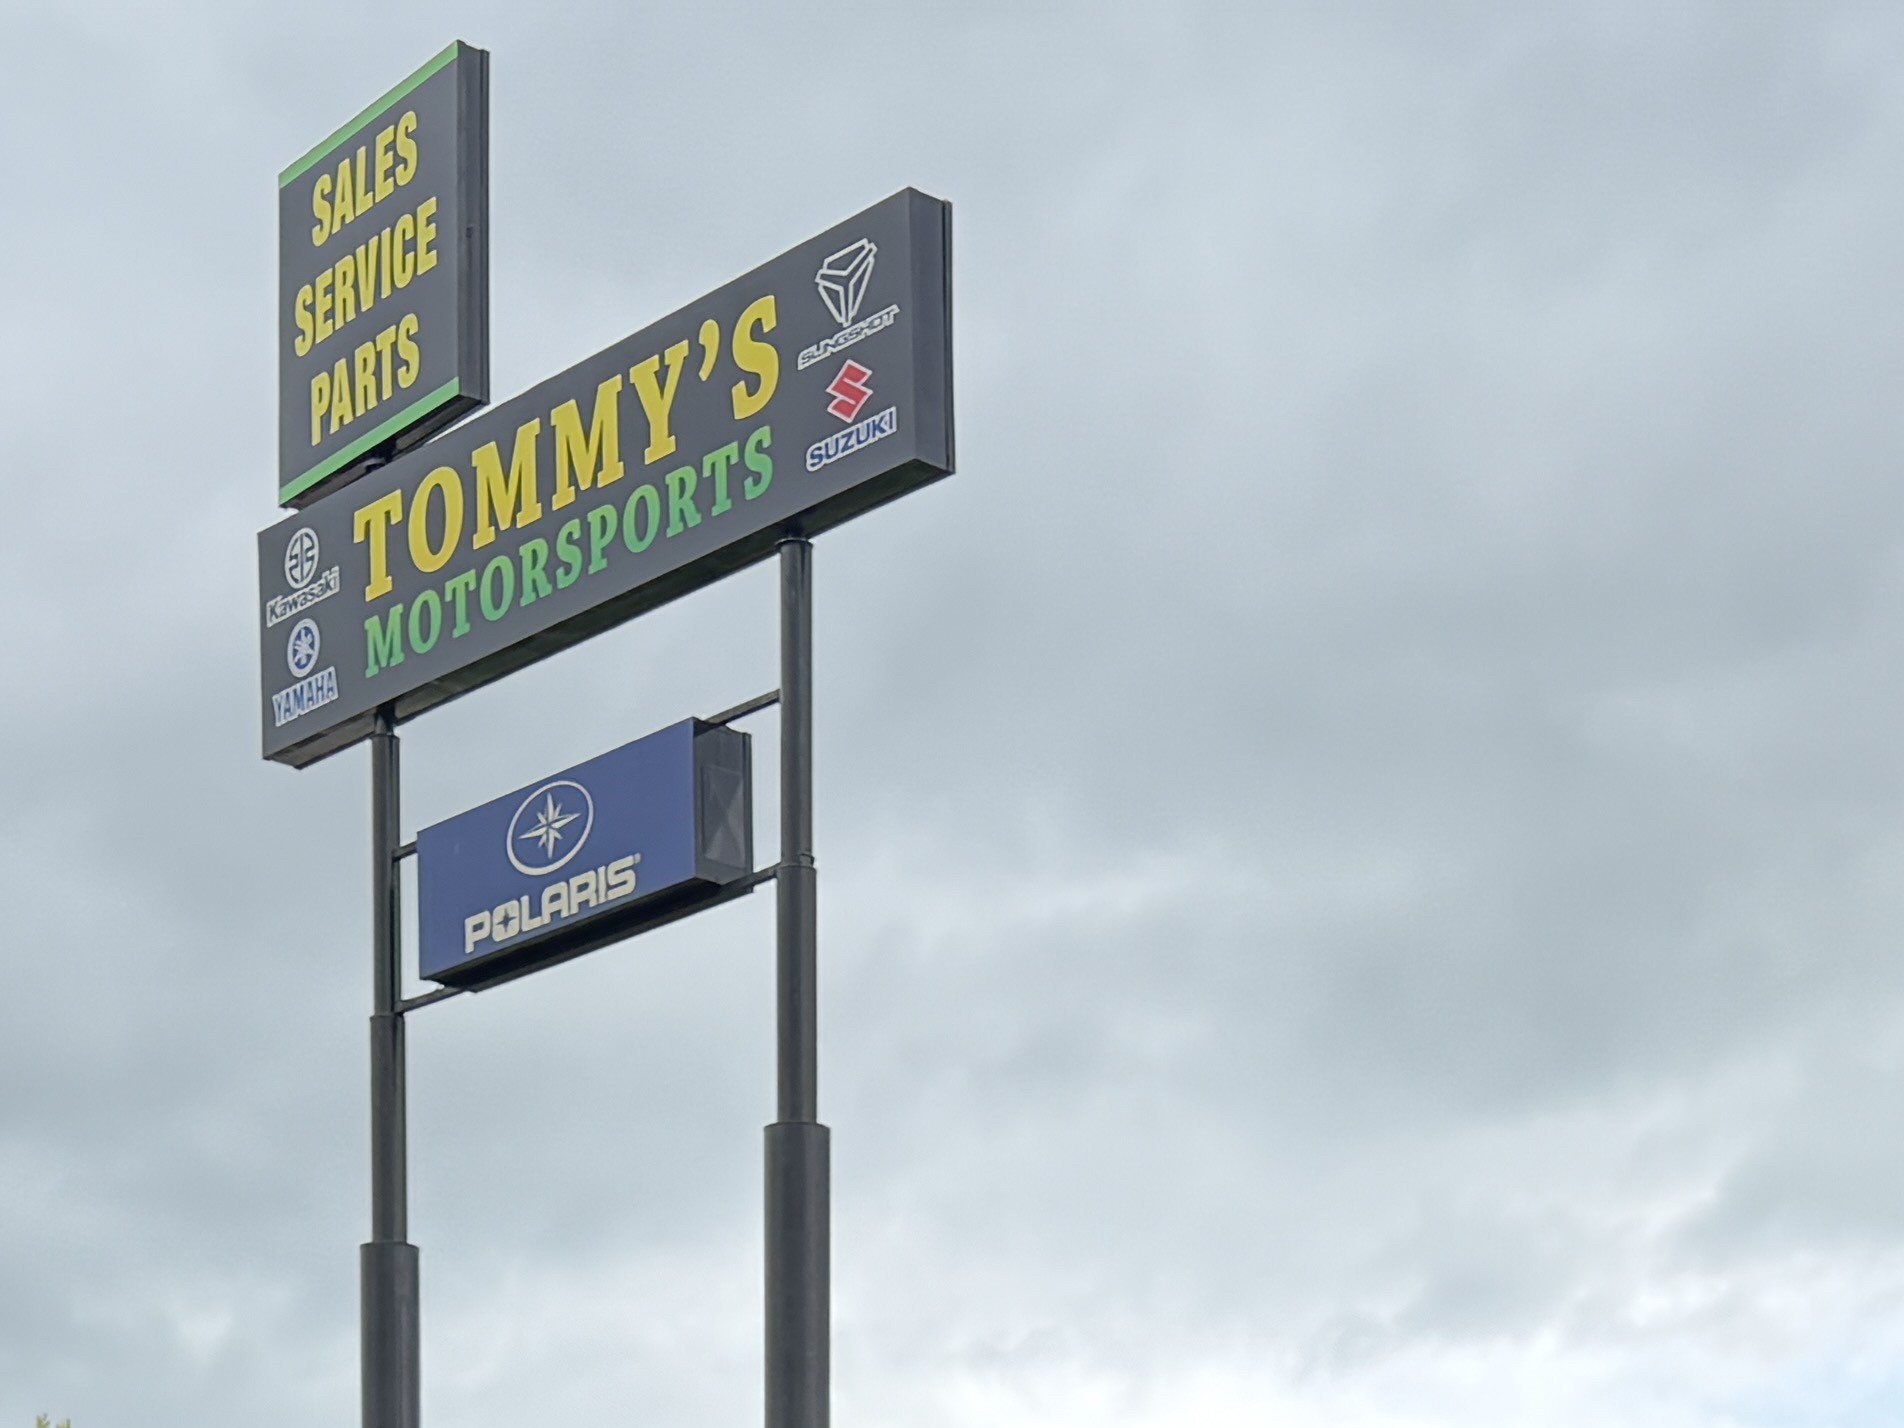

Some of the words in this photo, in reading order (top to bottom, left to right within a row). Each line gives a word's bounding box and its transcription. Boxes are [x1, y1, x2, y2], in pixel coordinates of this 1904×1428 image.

[312, 111, 417, 246] SALES
[294, 196, 438, 357] SERVICE
[310, 313, 420, 446] PARTS
[808, 408, 895, 469] SUZUKI
[353, 295, 780, 602] TOMMY'S
[268, 568, 338, 625] Kawasaki
[364, 427, 774, 679] MOTORSPORTS
[275, 670, 337, 724] YAMAHA
[464, 860, 637, 953] POLARIS
